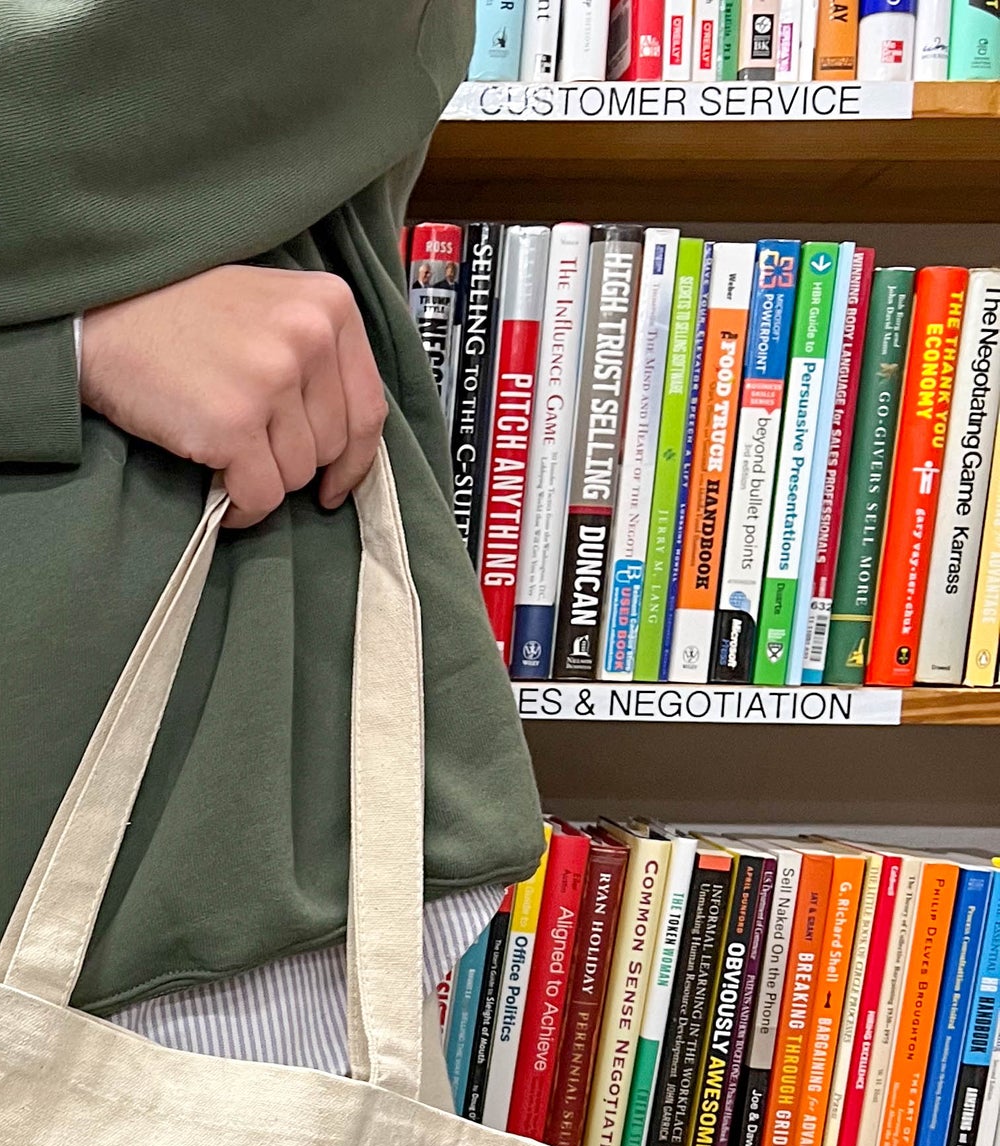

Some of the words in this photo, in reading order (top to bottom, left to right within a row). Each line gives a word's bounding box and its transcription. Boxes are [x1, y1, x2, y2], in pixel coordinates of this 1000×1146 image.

[479, 86, 687, 117] CUSTOMER
[700, 86, 862, 116] SERVICE
[426, 241, 453, 254] ROSS
[465, 243, 493, 356] SELLING
[600, 253, 633, 313] HIGH
[726, 273, 737, 301] Weber
[947, 291, 964, 328] THE
[593, 317, 628, 397] TRUST
[916, 323, 944, 420] ECONOMY
[937, 336, 959, 403] THANK
[496, 373, 533, 450] PITCH
[932, 410, 949, 449] YOU
[583, 399, 619, 500] SELLING
[484, 456, 526, 586] ANYTHING
[655, 510, 669, 554] JERRY
[570, 525, 607, 626] DUNCAN
[653, 559, 664, 573] M.
[946, 526, 970, 594] Karrass
[648, 583, 662, 624] LANG
[519, 688, 562, 715] ES
[574, 689, 595, 716] &
[610, 690, 852, 720] NEGOTIATION
[594, 872, 611, 915] RYAN
[632, 860, 659, 951] COMMON
[673, 893, 685, 911] THE
[667, 911, 682, 945] TOKEN
[509, 936, 528, 983] Office
[581, 921, 604, 994] HOLIDAY
[657, 949, 674, 987] WOMAN
[501, 986, 520, 1042] Politics
[619, 961, 643, 1030] SENSE
[789, 953, 815, 1029] BREAKING
[778, 1036, 802, 1105] THROUGH
